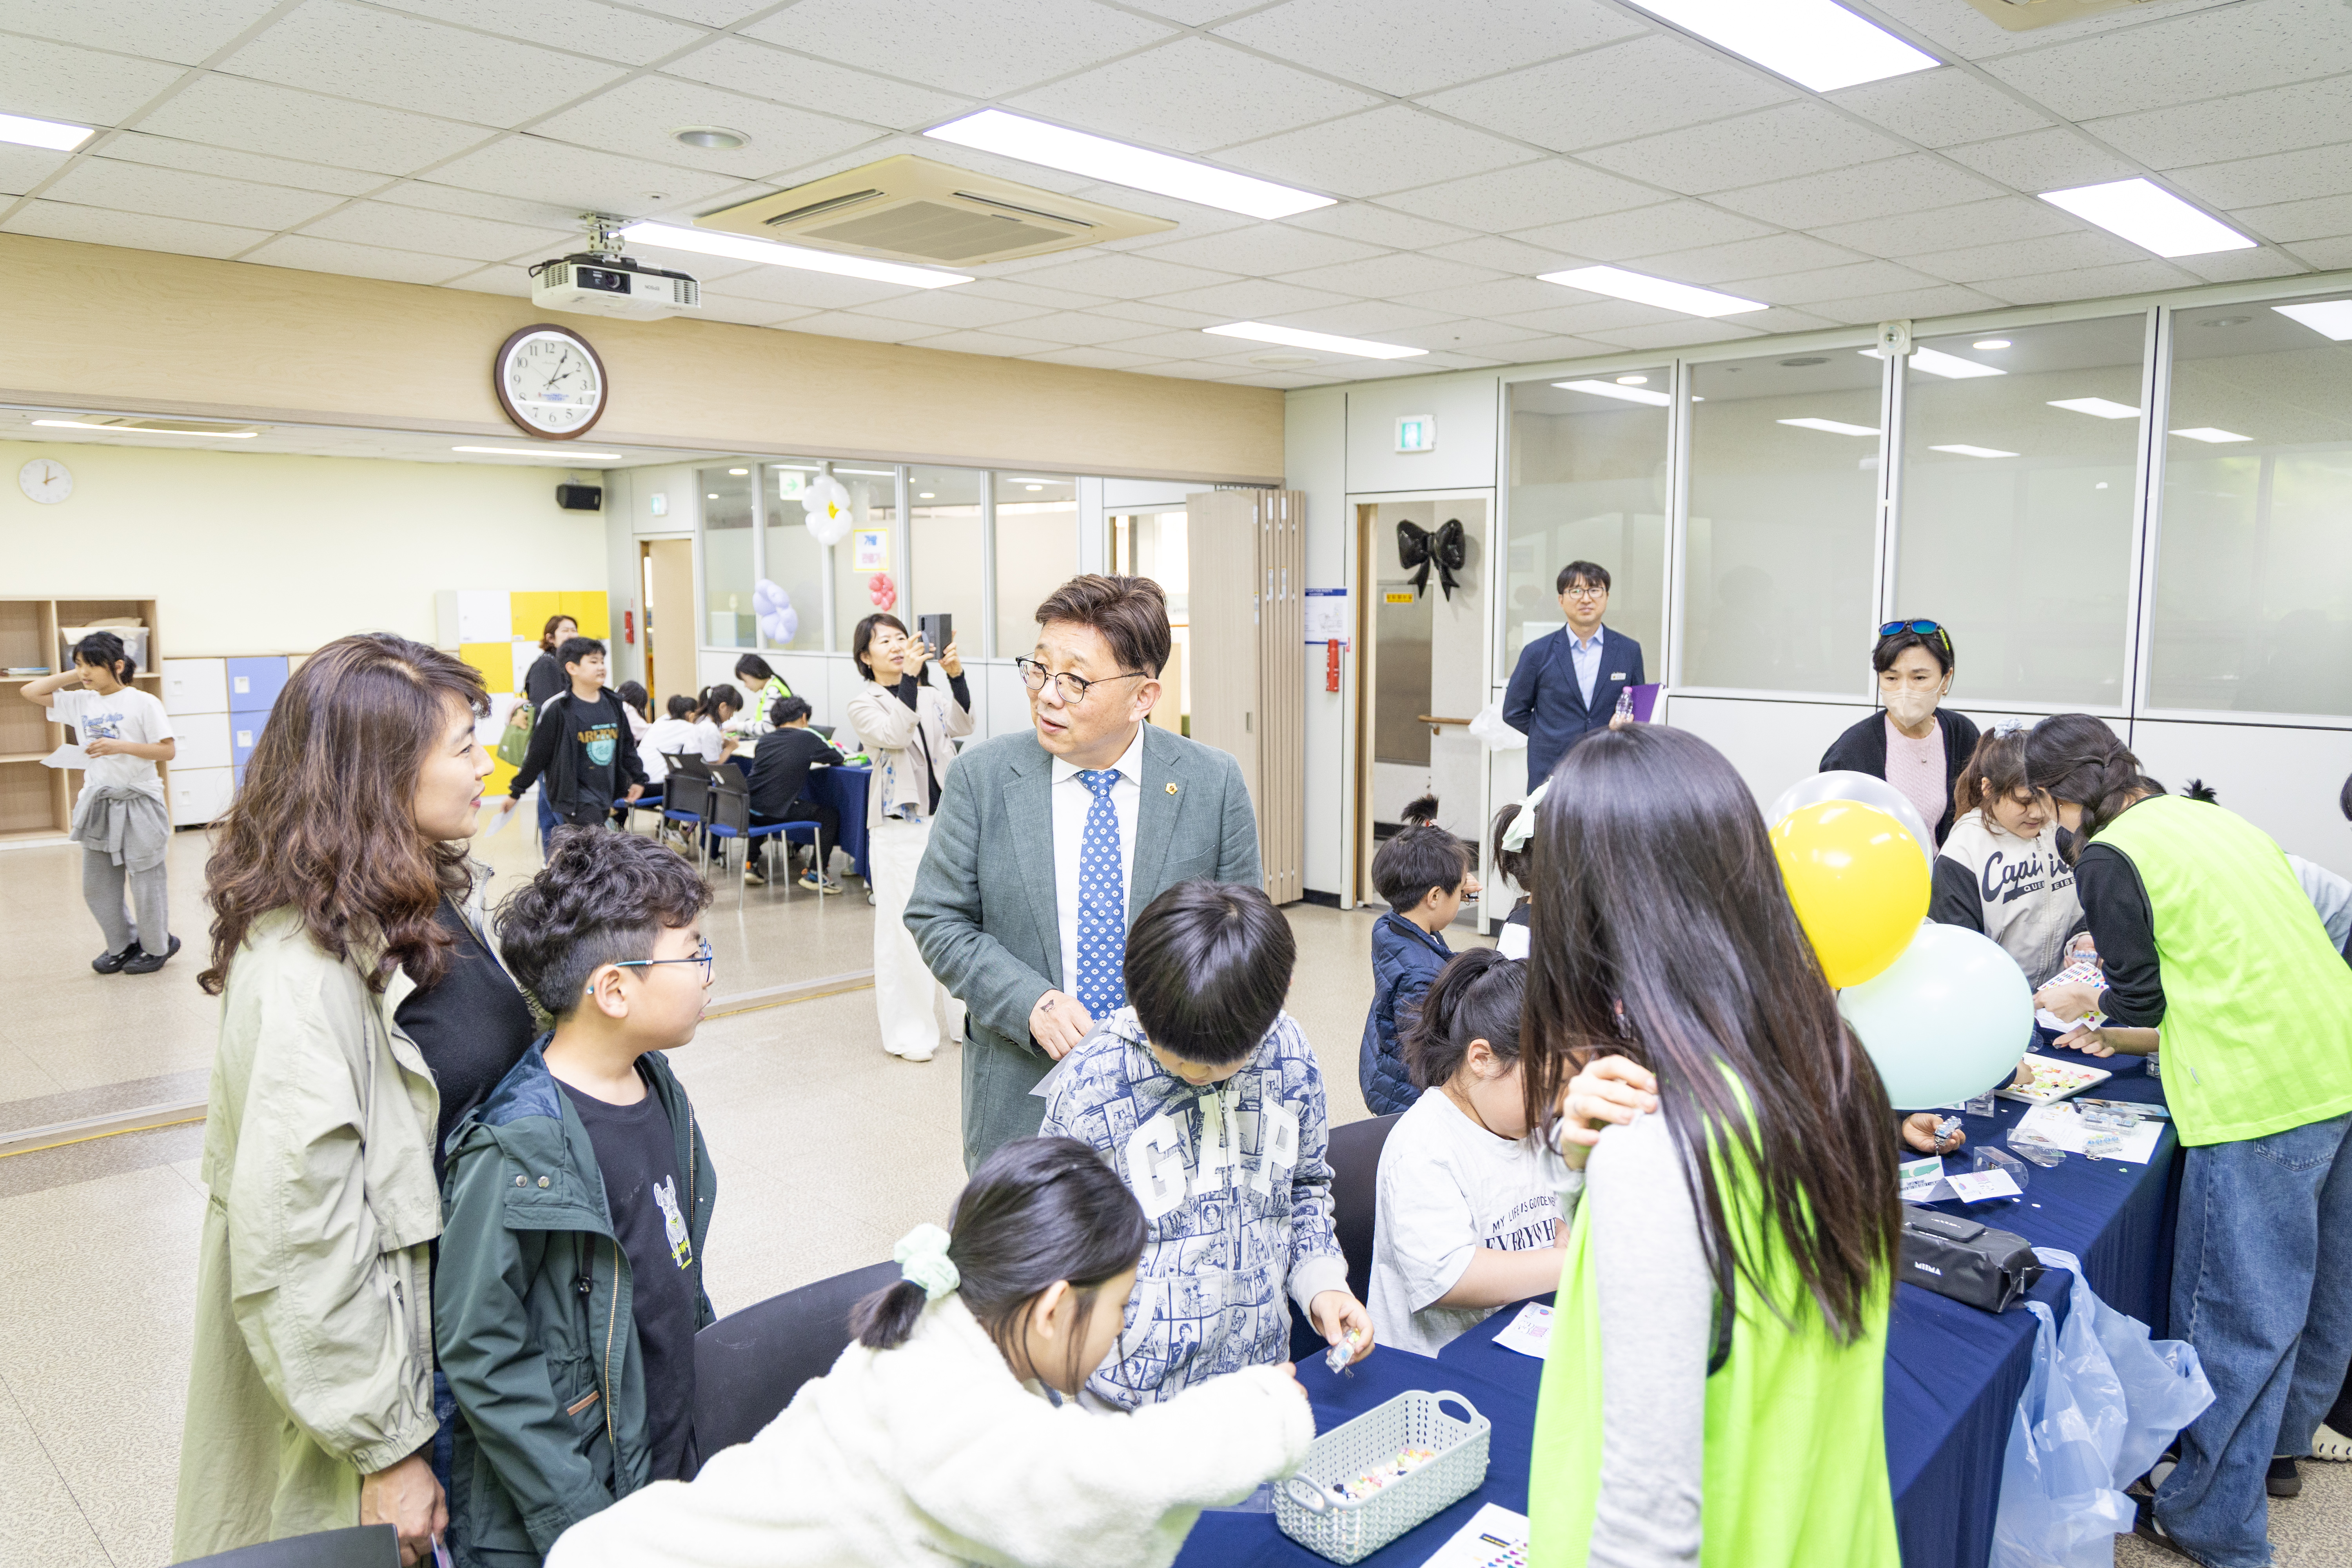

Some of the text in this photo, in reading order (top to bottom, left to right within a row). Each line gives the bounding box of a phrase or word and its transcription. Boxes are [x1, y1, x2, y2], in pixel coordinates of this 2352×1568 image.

[530, 345, 537, 356] 11
[545, 343, 555, 353] 12
[517, 357, 527, 368] 10
[576, 361, 581, 372] 2
[513, 374, 521, 384] 9
[580, 379, 587, 390] 3
[519, 392, 526, 401] 8
[532, 407, 538, 417] 7
[549, 412, 556, 422] 6
[566, 408, 572, 419] 5
[1125, 1091, 1300, 1220] GAP
[1493, 1216, 1504, 1233] MY
[1509, 1205, 1519, 1221] LIFE
[1521, 1202, 1528, 1212] IS
